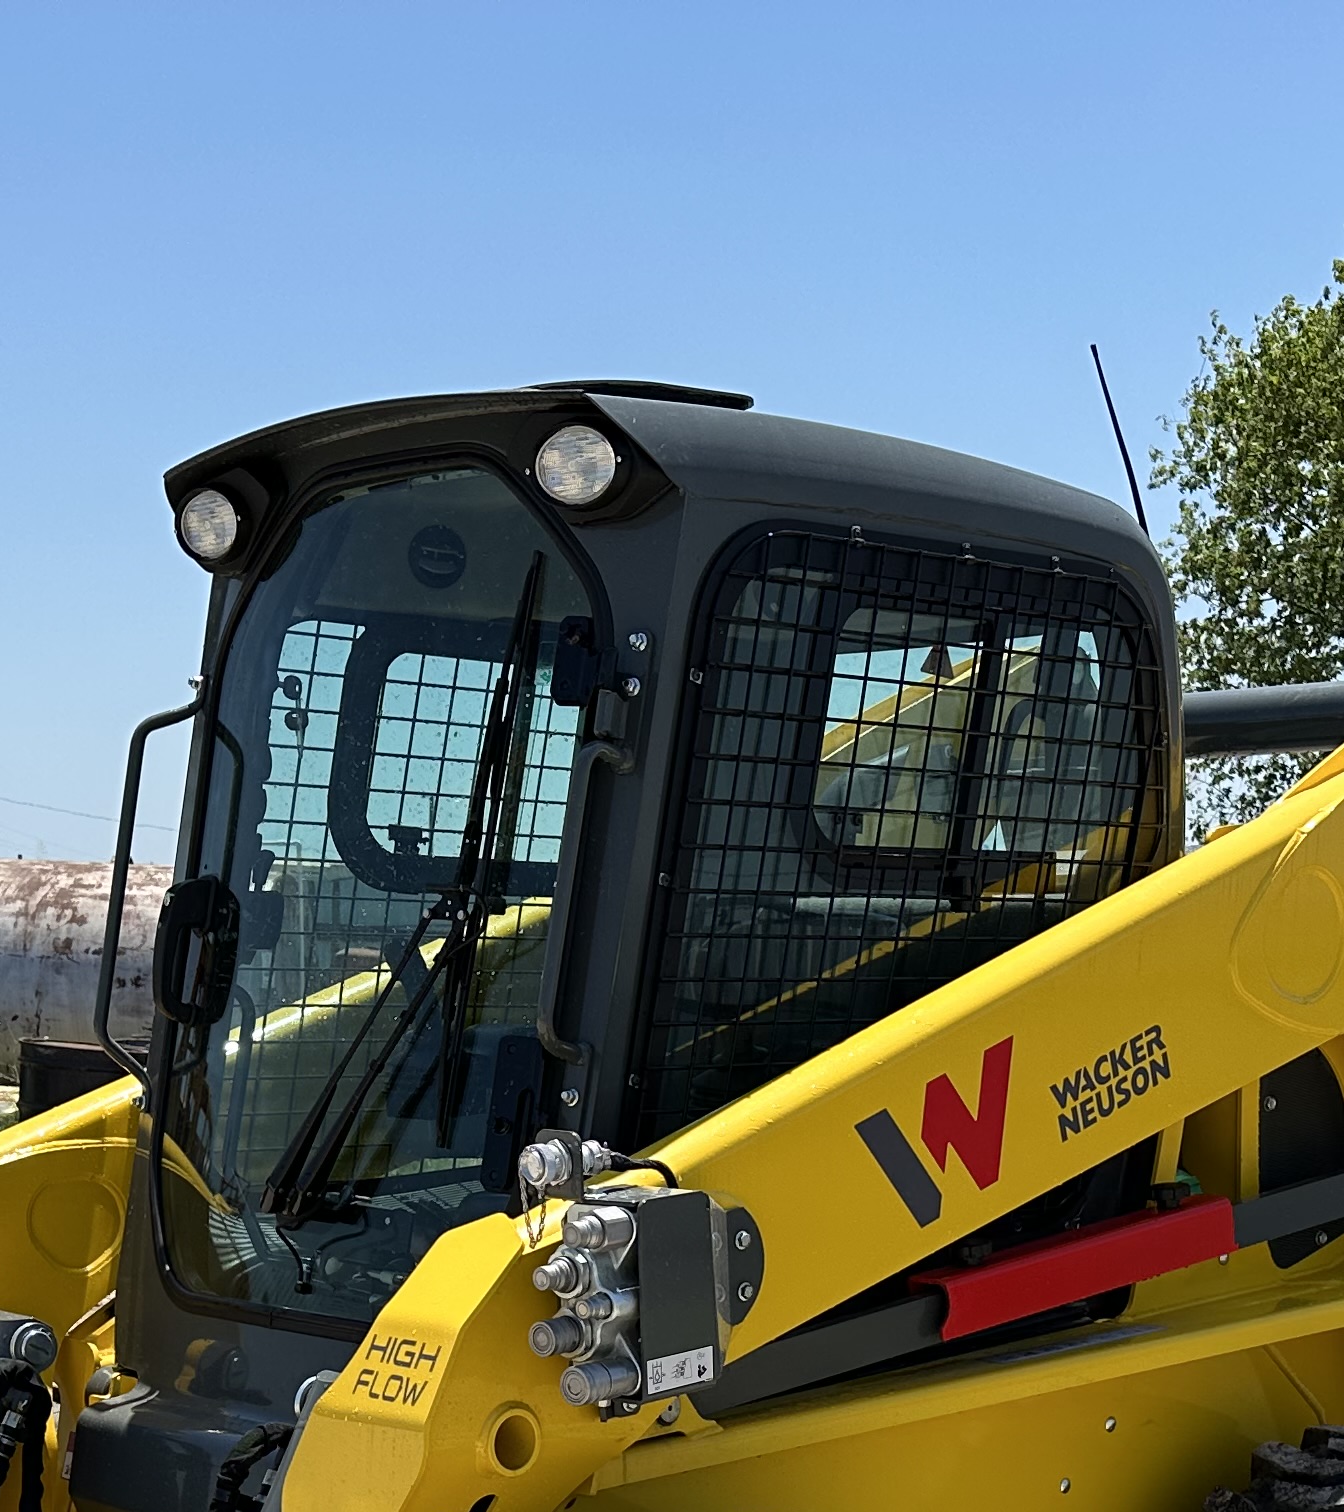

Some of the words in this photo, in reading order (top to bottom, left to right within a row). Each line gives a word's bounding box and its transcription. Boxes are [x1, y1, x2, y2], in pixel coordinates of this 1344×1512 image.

[1049, 1024, 1166, 1109] WACKER
[1057, 1051, 1171, 1143] NEUSON
[365, 1334, 442, 1372] HIGH
[352, 1369, 429, 1406] FLOW
